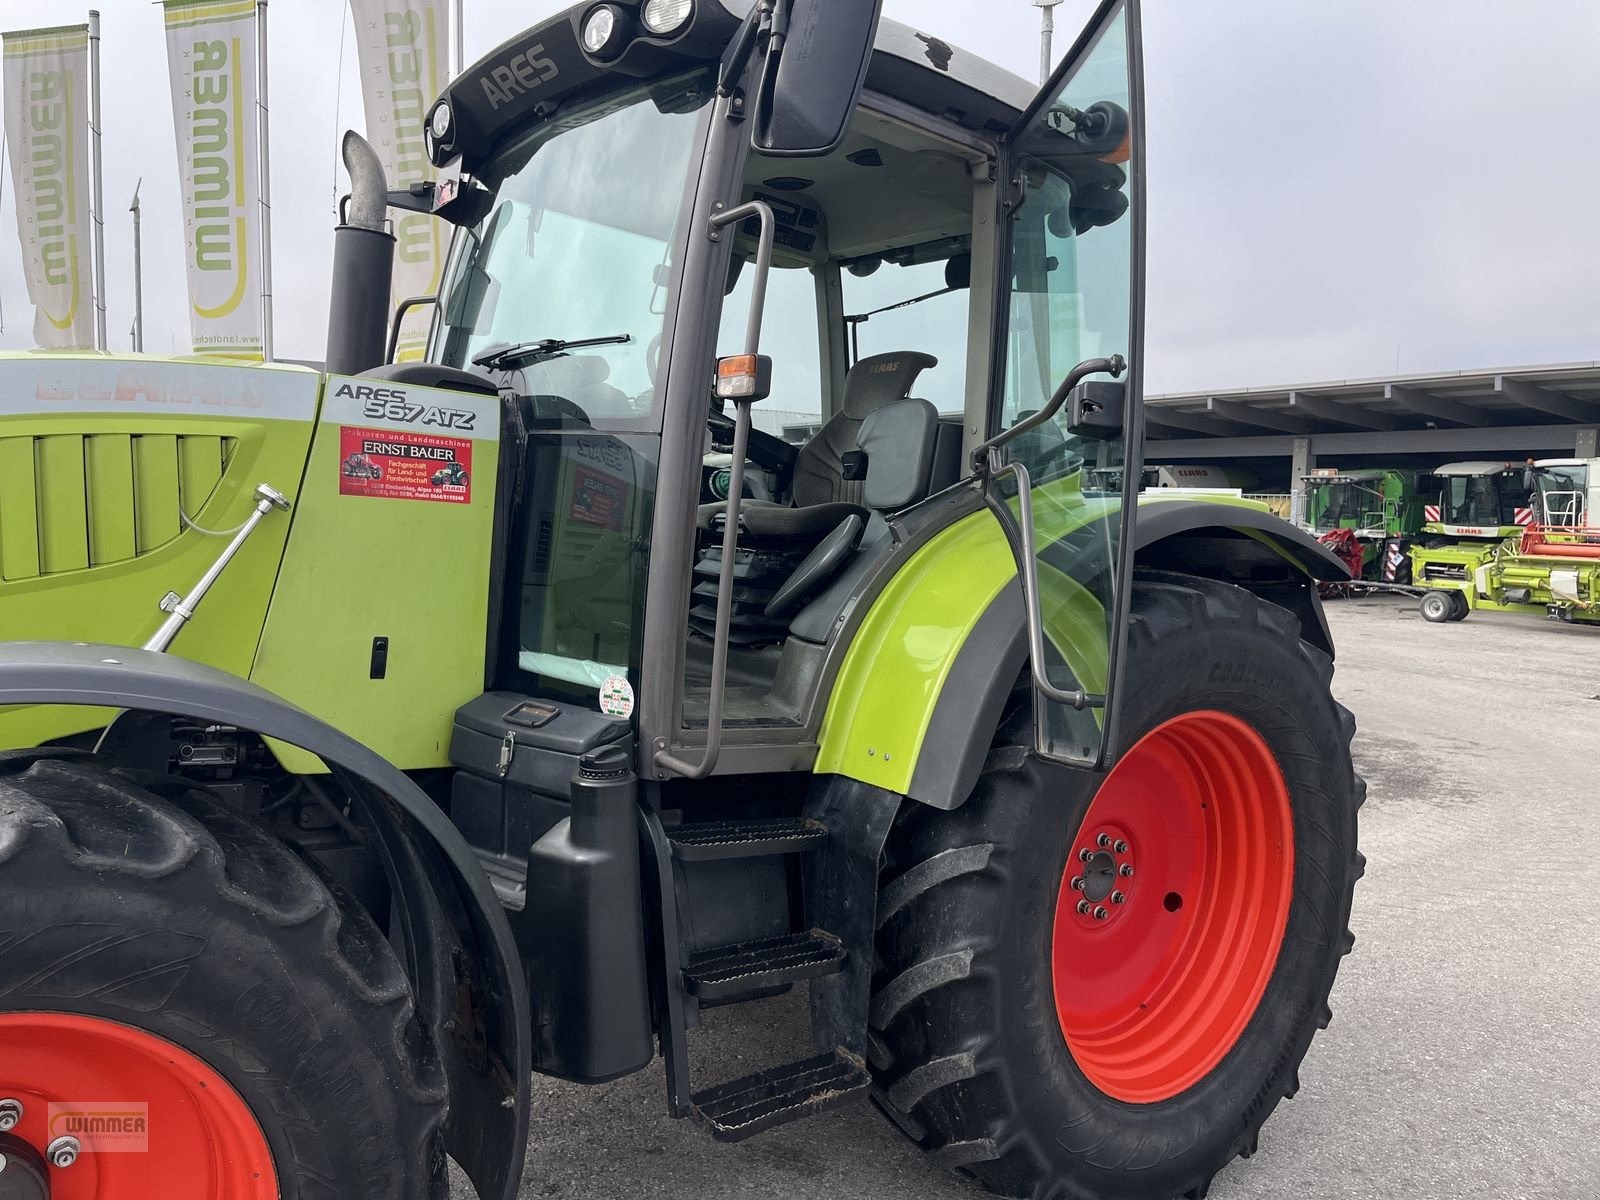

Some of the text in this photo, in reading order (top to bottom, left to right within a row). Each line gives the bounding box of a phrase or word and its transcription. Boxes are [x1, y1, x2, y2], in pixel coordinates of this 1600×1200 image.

[479, 42, 560, 111] ARES
[335, 384, 407, 403] ARES
[388, 433, 405, 441] und
[408, 435, 471, 448] Landmaschinen
[363, 441, 454, 461] ERNST BAUER
[388, 459, 427, 470] Fachgeschäft
[387, 467, 396, 475] für
[397, 468, 415, 476] Land-
[1178, 469, 1208, 477] CLAAS
[386, 475, 428, 484] Forstwirtschaft
